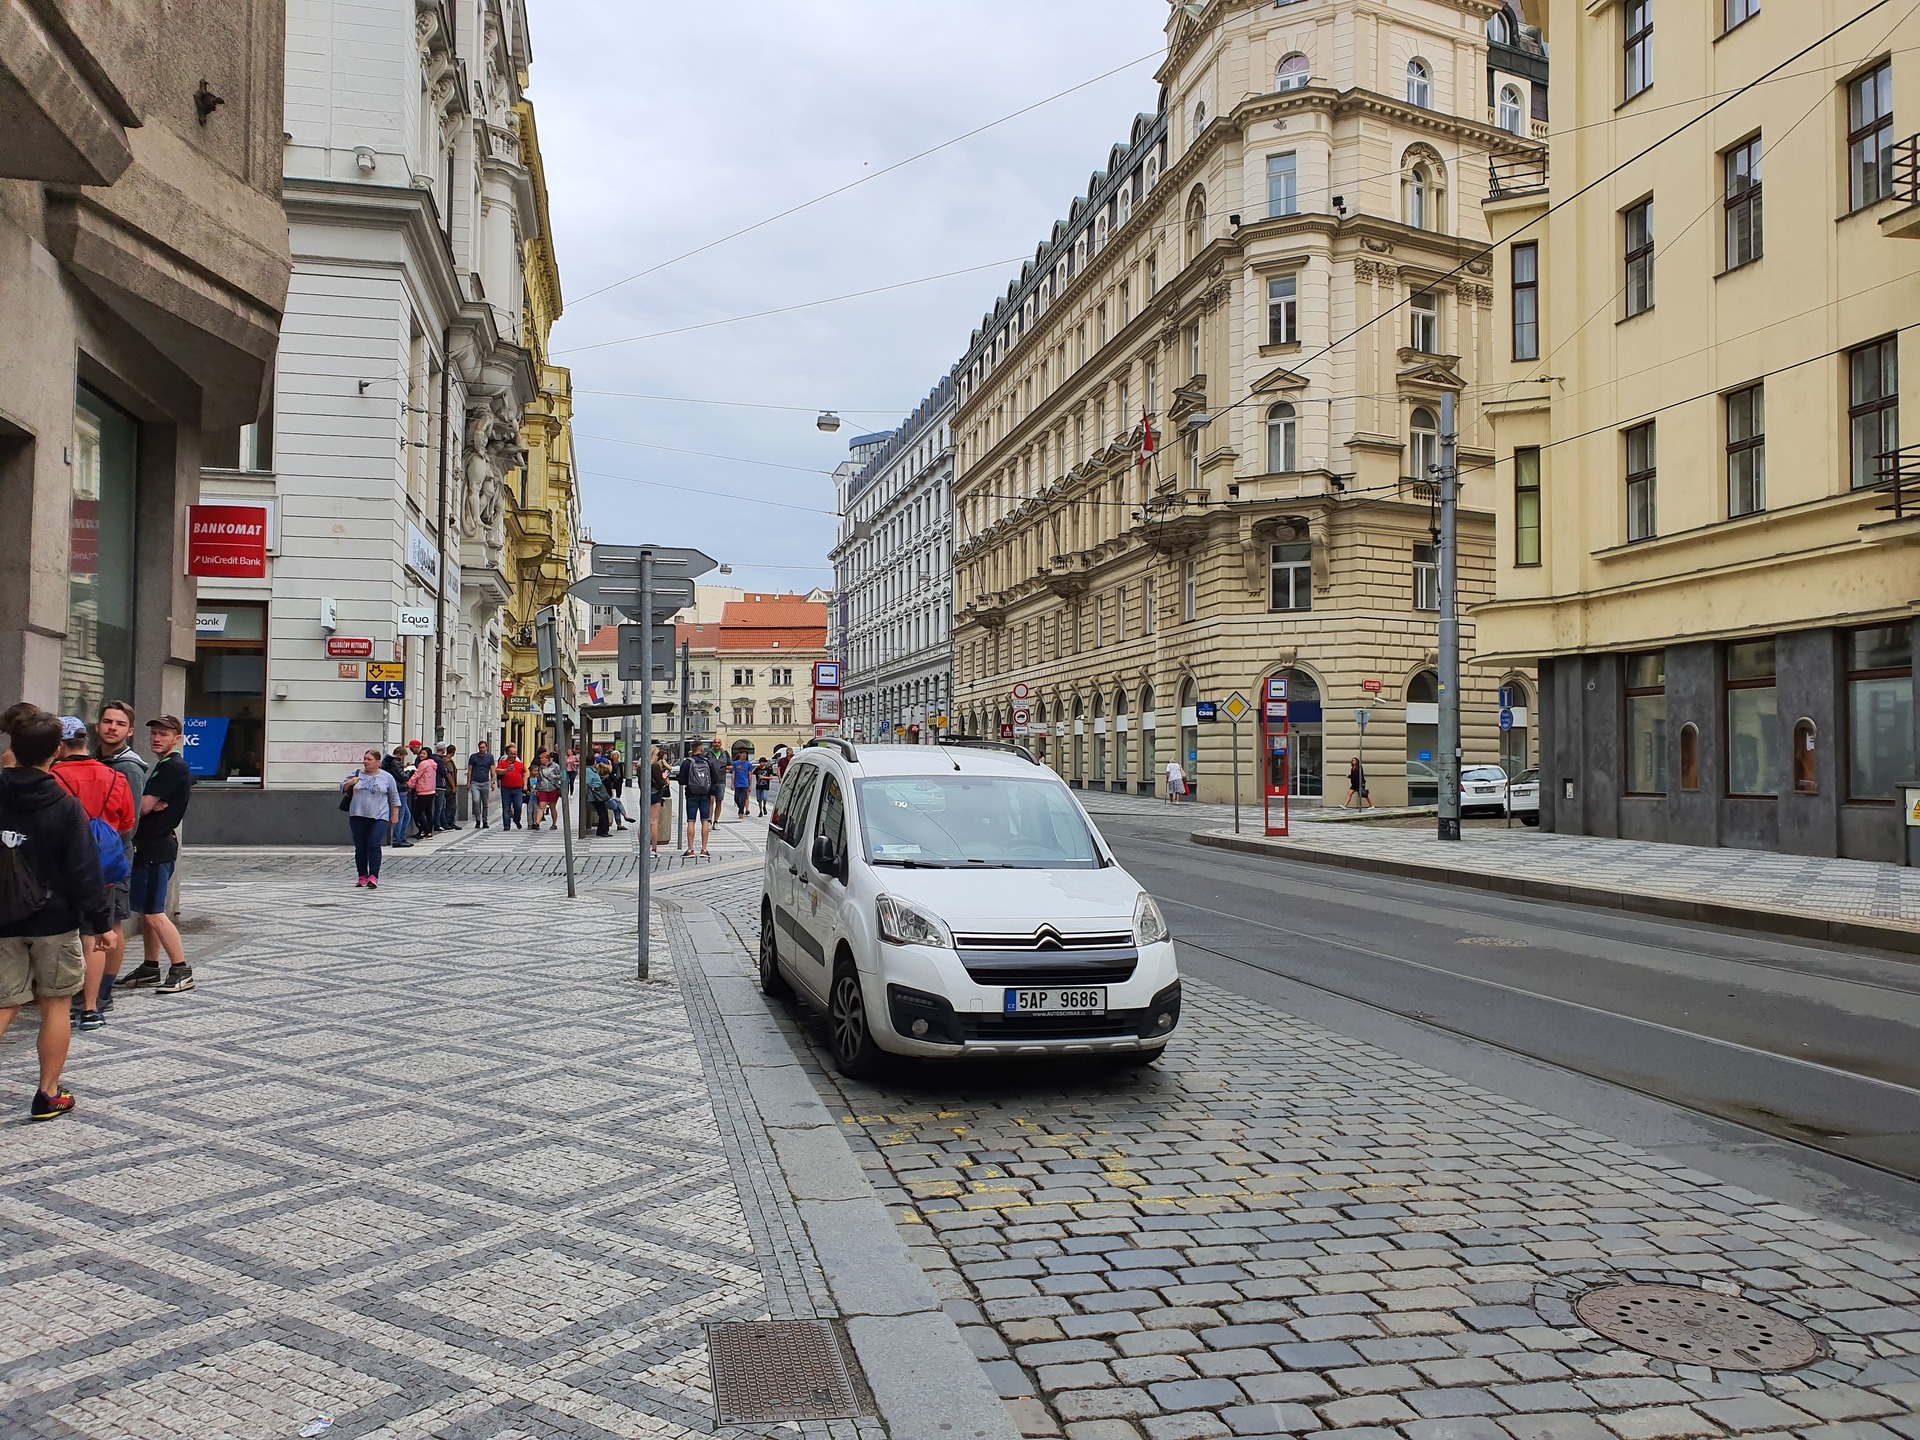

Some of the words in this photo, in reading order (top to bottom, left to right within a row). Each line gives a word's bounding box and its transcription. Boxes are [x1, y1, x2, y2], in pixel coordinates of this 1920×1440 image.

[193, 522, 262, 536] BANKOMAT
[201, 555, 239, 565] UniCredit
[239, 556, 262, 566] Bank
[402, 614, 429, 624] Equa
[187, 718, 207, 727] účet
[1020, 992, 1048, 1008] 5AP
[1060, 991, 1098, 1008] 9686
